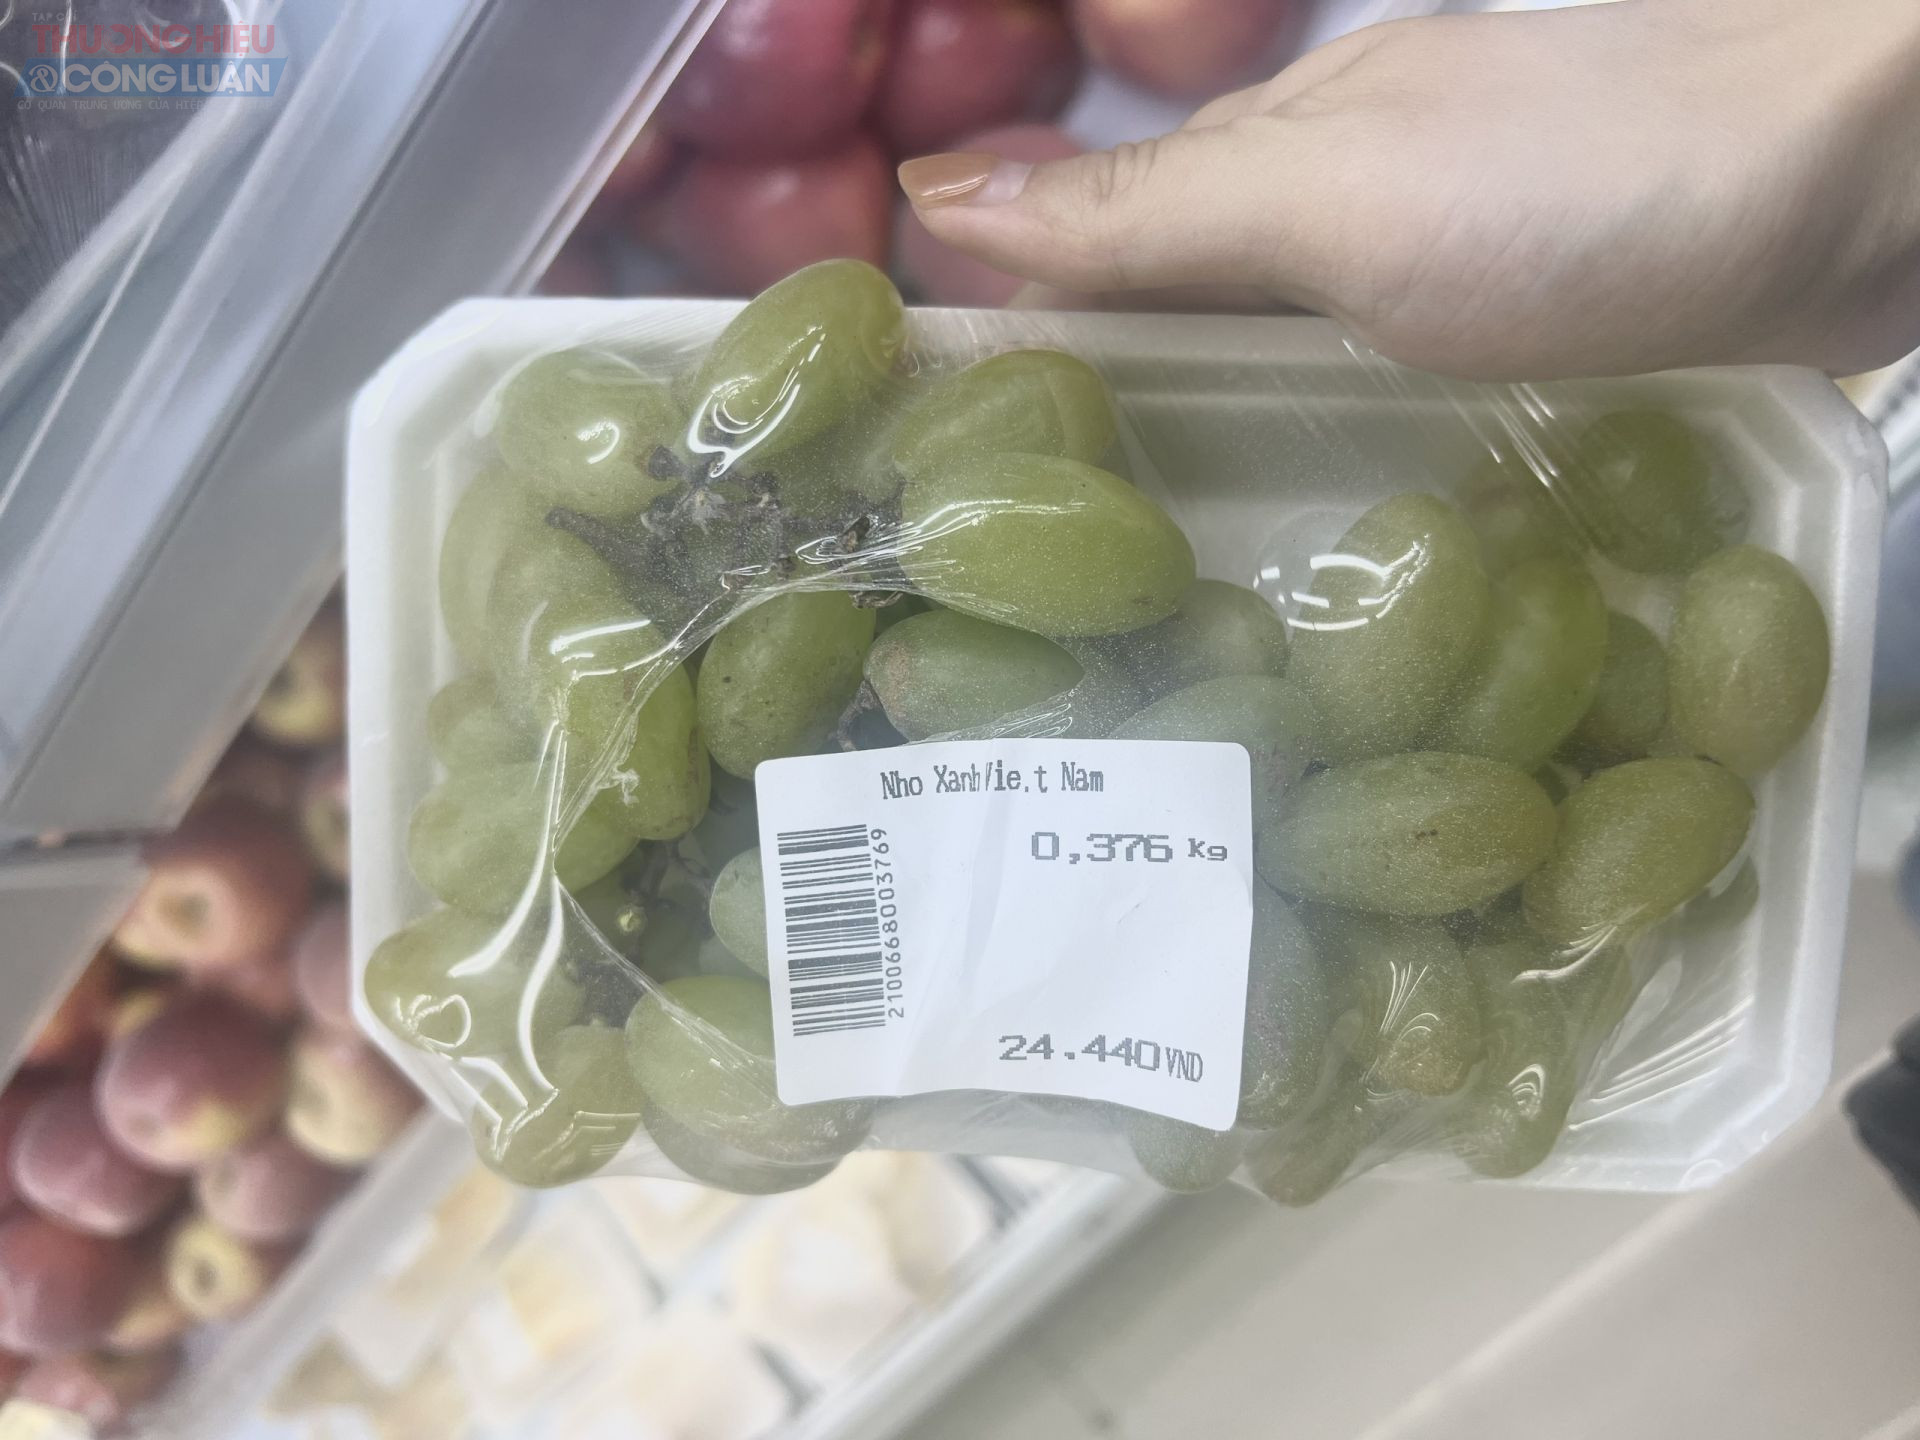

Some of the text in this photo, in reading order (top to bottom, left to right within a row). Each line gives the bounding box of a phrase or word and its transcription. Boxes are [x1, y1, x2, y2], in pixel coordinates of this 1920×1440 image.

[880, 770, 923, 799] Nho
[1061, 761, 1104, 792] Nam
[1031, 831, 1173, 864] 0,376
[870, 828, 905, 1018] 2100668003769
[998, 1033, 1204, 1082] 24.440 VND
